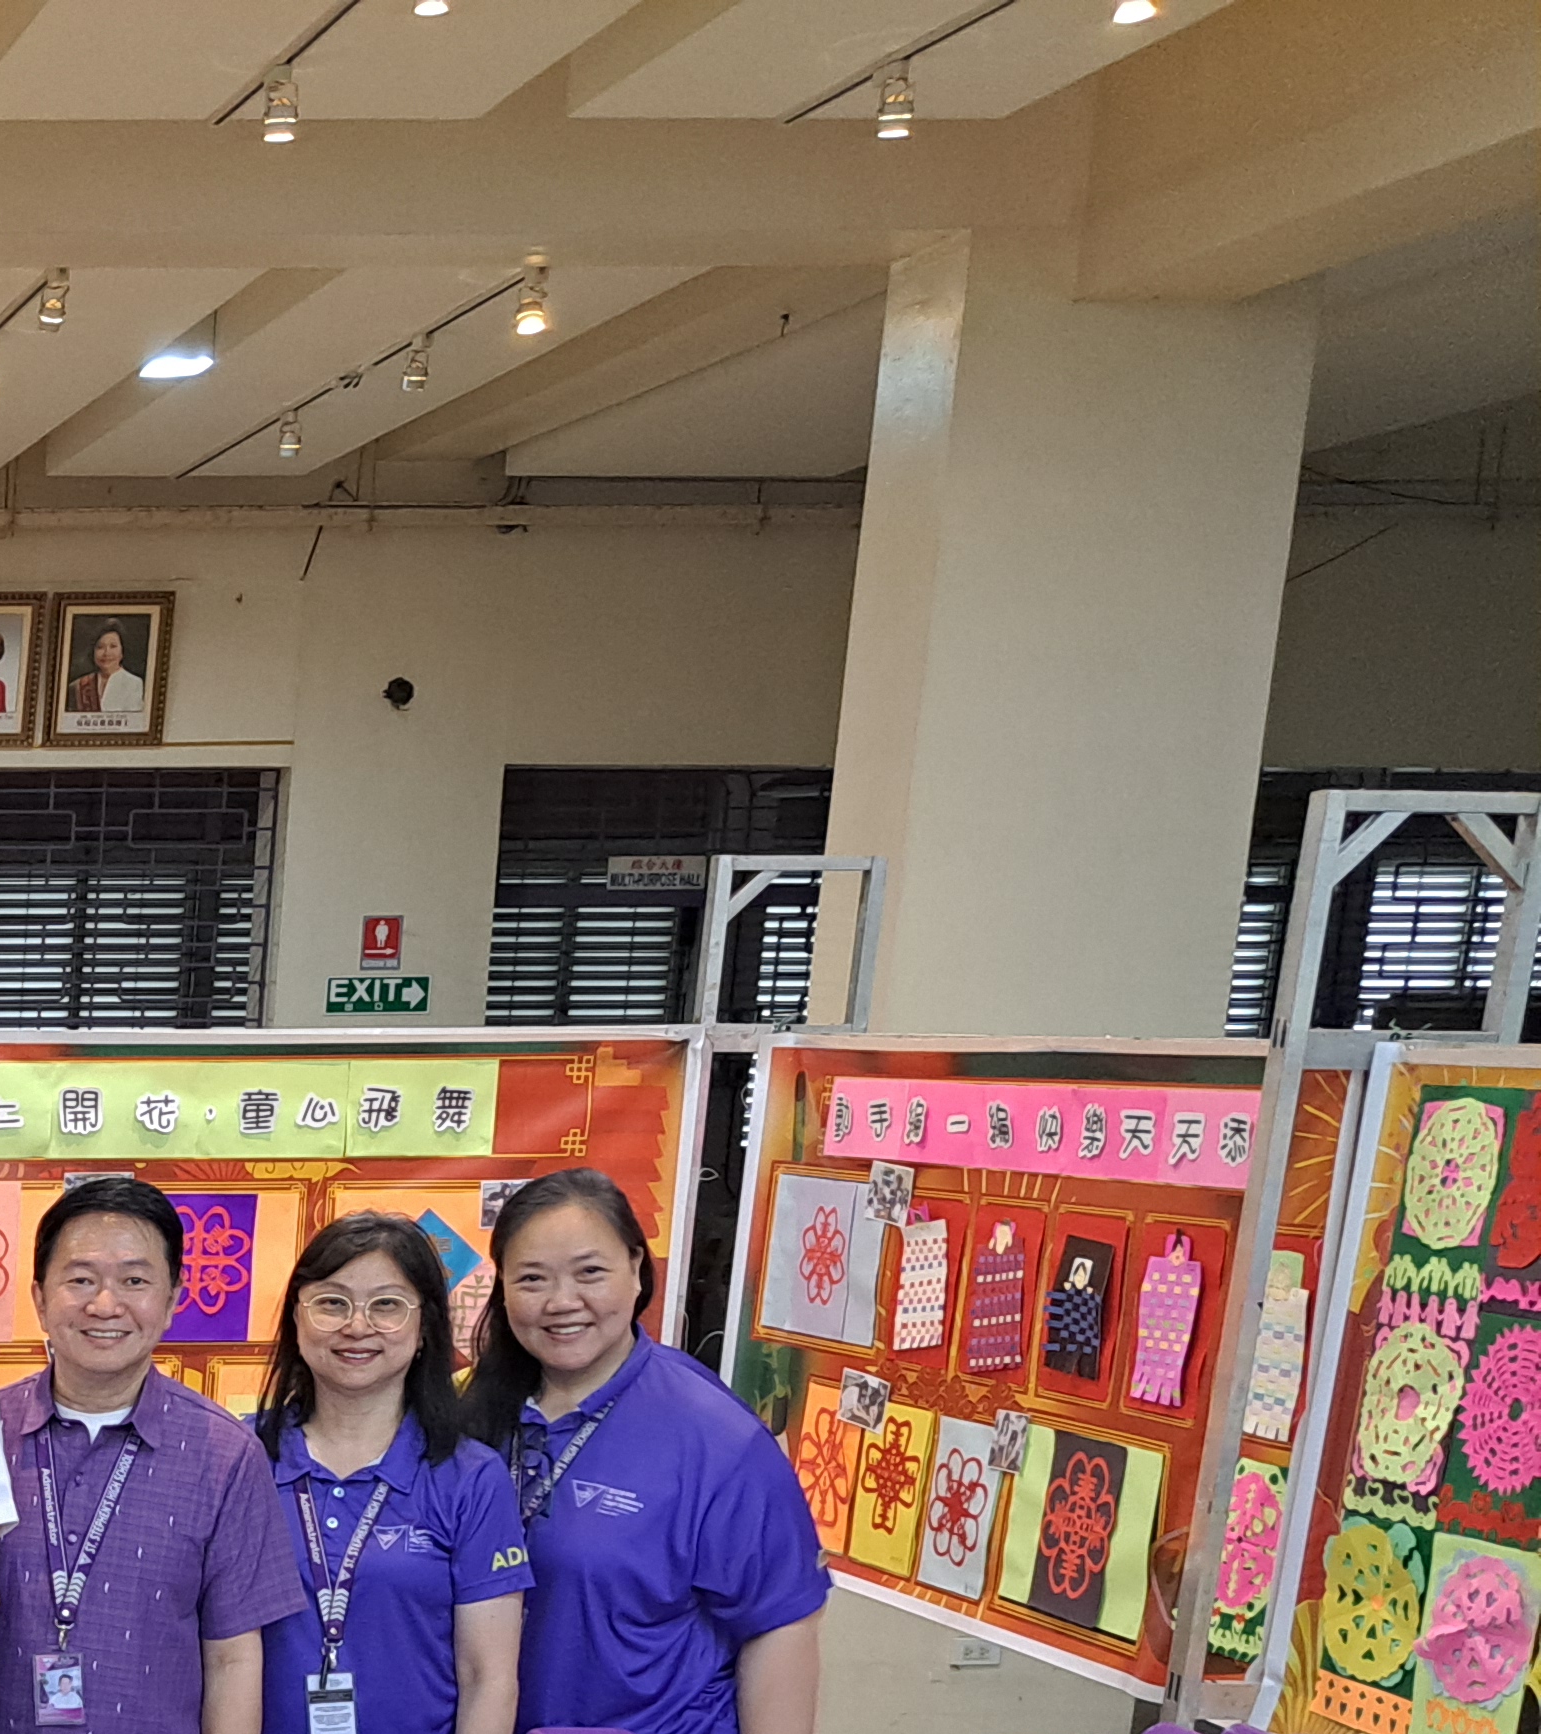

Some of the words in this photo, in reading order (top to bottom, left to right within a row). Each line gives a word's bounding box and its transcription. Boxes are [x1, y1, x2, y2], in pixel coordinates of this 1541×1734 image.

[329, 978, 403, 1003] EXIT
[112, 1451, 134, 1482] SCHOOL
[105, 1479, 122, 1501] HIGH
[40, 1467, 59, 1547] Administrator
[88, 1498, 115, 1542] STEPHEN'S
[83, 1538, 98, 1554] ST.
